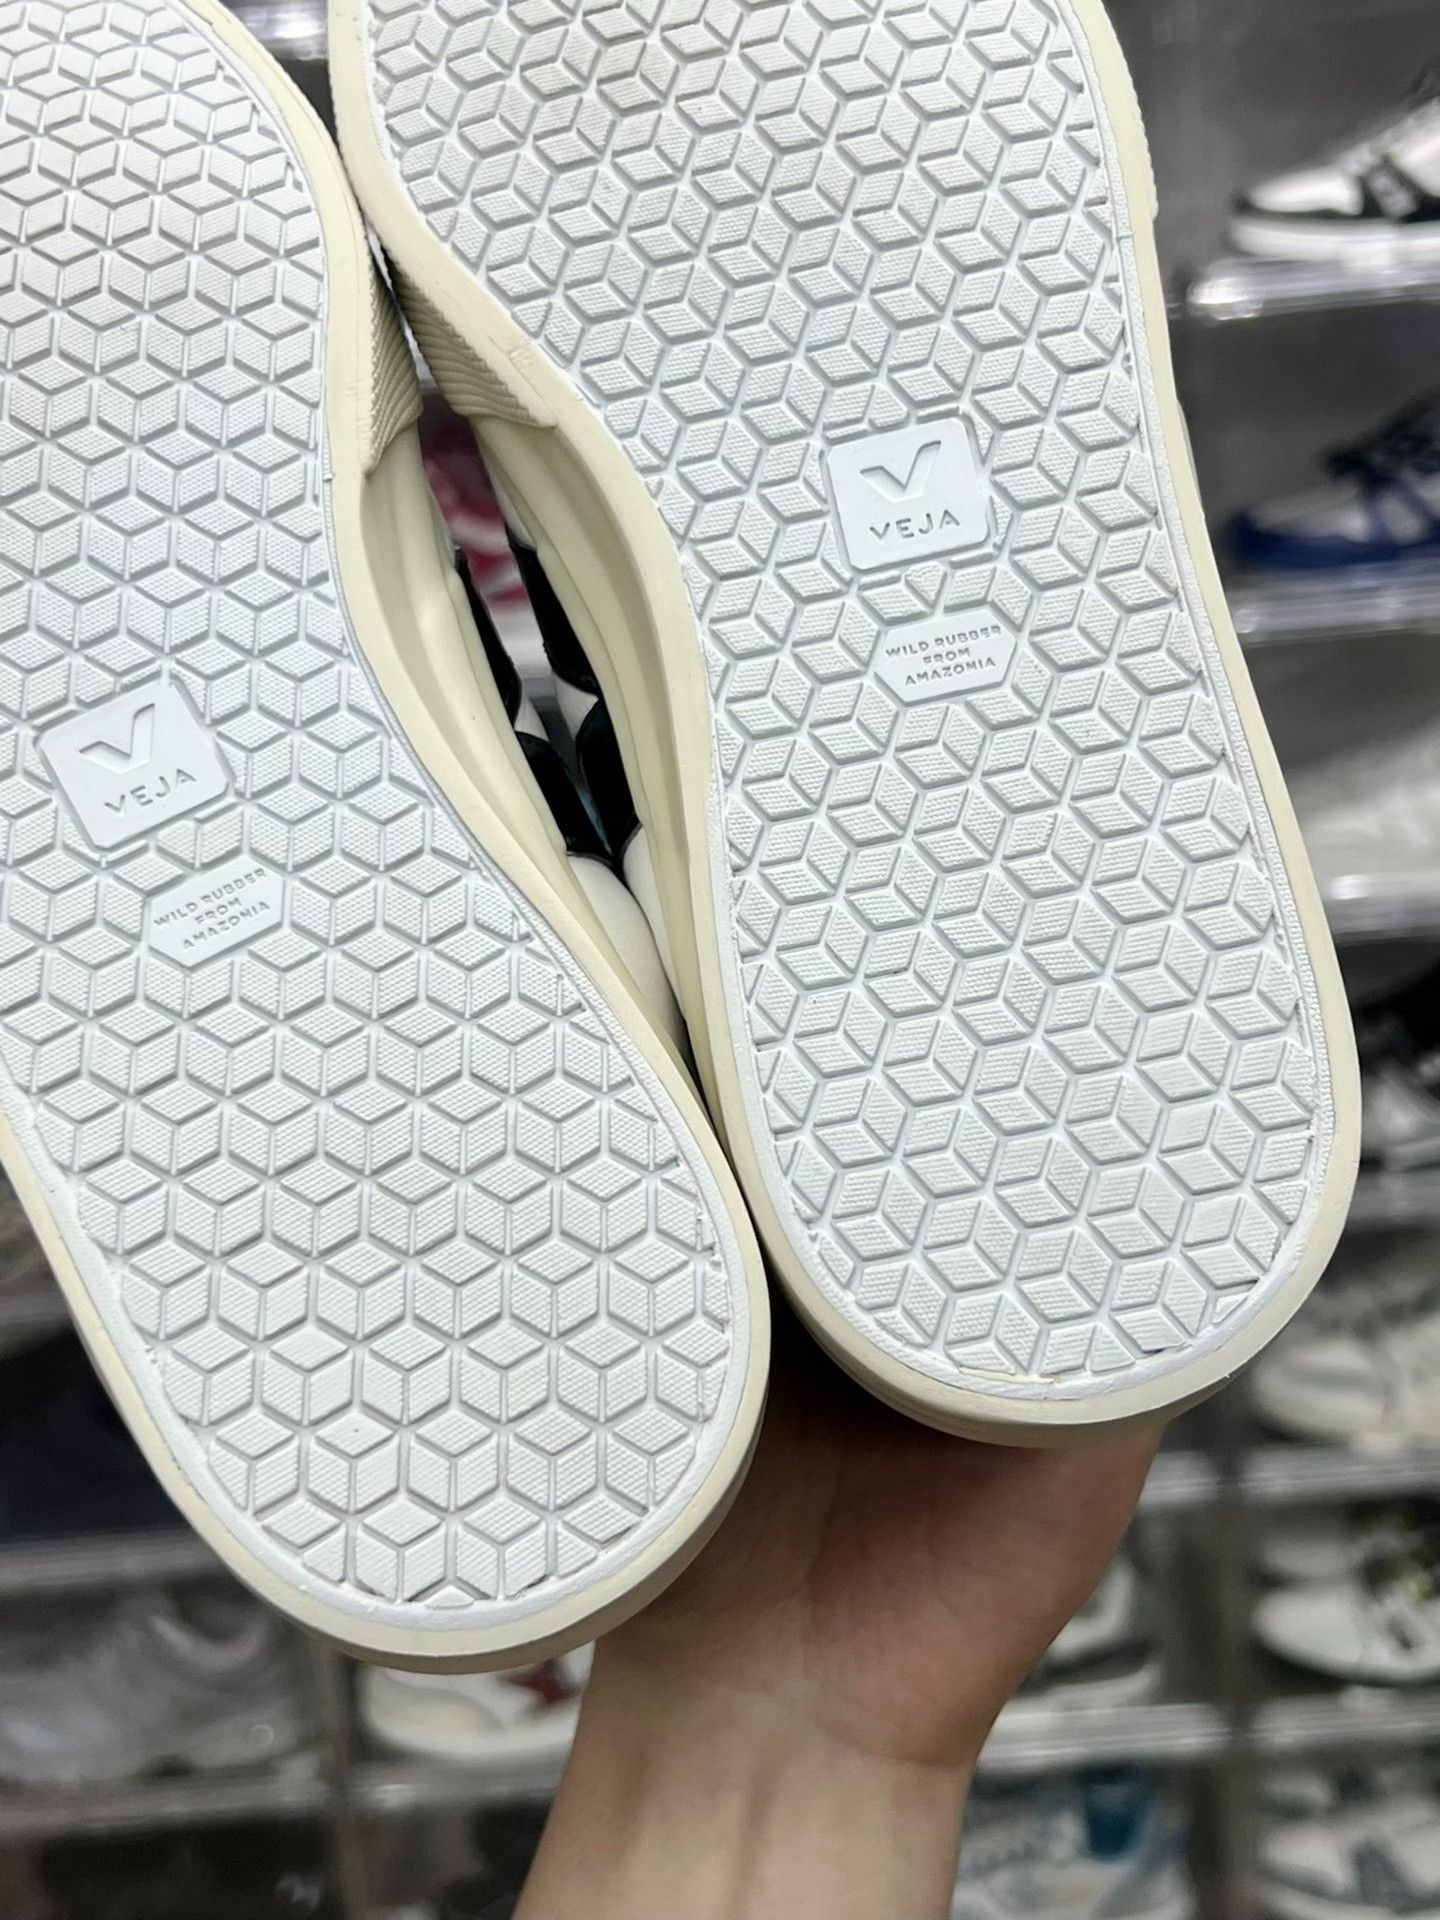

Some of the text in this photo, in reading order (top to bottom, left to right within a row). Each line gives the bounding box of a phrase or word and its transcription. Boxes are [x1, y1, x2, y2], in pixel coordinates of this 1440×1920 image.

[869, 509, 960, 540] VEJA
[885, 625, 1001, 657] WILD RUBBER
[923, 647, 970, 663] FROM
[905, 657, 996, 685] AMAZONIA
[104, 768, 197, 817] VEJA
[153, 868, 266, 926] WILD RUBBER
[195, 897, 242, 923] FROM
[183, 901, 270, 949] AMAZONIA
